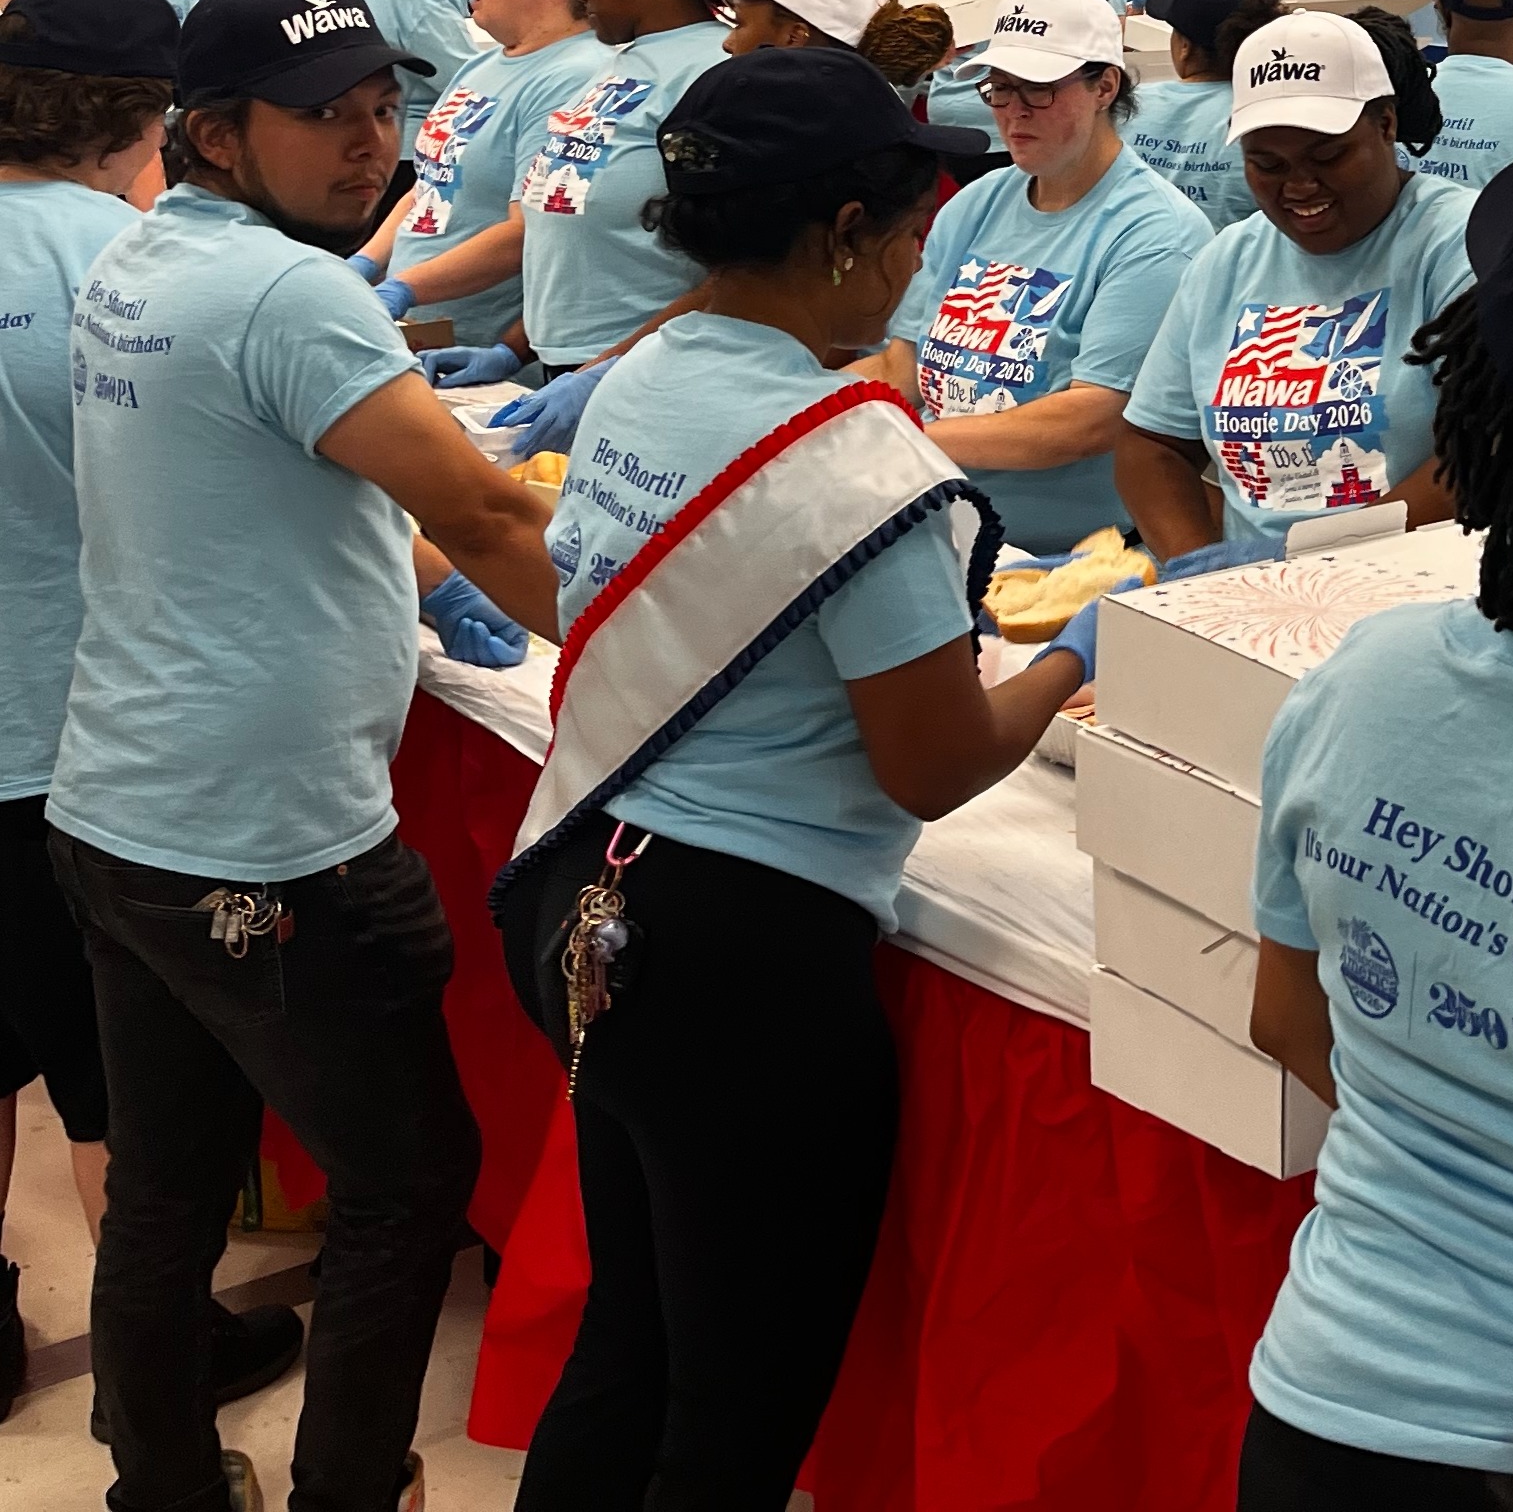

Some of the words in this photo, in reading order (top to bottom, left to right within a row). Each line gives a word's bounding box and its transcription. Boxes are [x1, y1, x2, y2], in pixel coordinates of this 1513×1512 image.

[281, 5, 371, 45] Wawa
[994, 14, 1048, 37] Wawa
[1250, 62, 1321, 88] Wawa
[1444, 118, 1475, 130] orti!
[566, 141, 603, 162] 2026
[1134, 133, 1164, 151] Hey
[1450, 137, 1500, 152] birthday
[1184, 160, 1232, 172] birthday
[0, 312, 37, 329] day
[930, 312, 999, 351] Wawa
[117, 334, 177, 355] birthday
[921, 340, 965, 370] Hoagie
[964, 354, 996, 377] Day
[995, 361, 1035, 383] 2026
[1220, 375, 1316, 408] Wawa
[1213, 411, 1279, 439] Hoagie
[1283, 411, 1322, 437] Day
[1325, 402, 1373, 429] 2026
[591, 438, 623, 475] Hey
[618, 452, 687, 500] Shorti!
[1267, 444, 1304, 469] We
[586, 478, 637, 528] Nation's
[1362, 797, 1445, 863] Hey
[1326, 848, 1374, 883] our
[1376, 863, 1509, 957] Nation's
